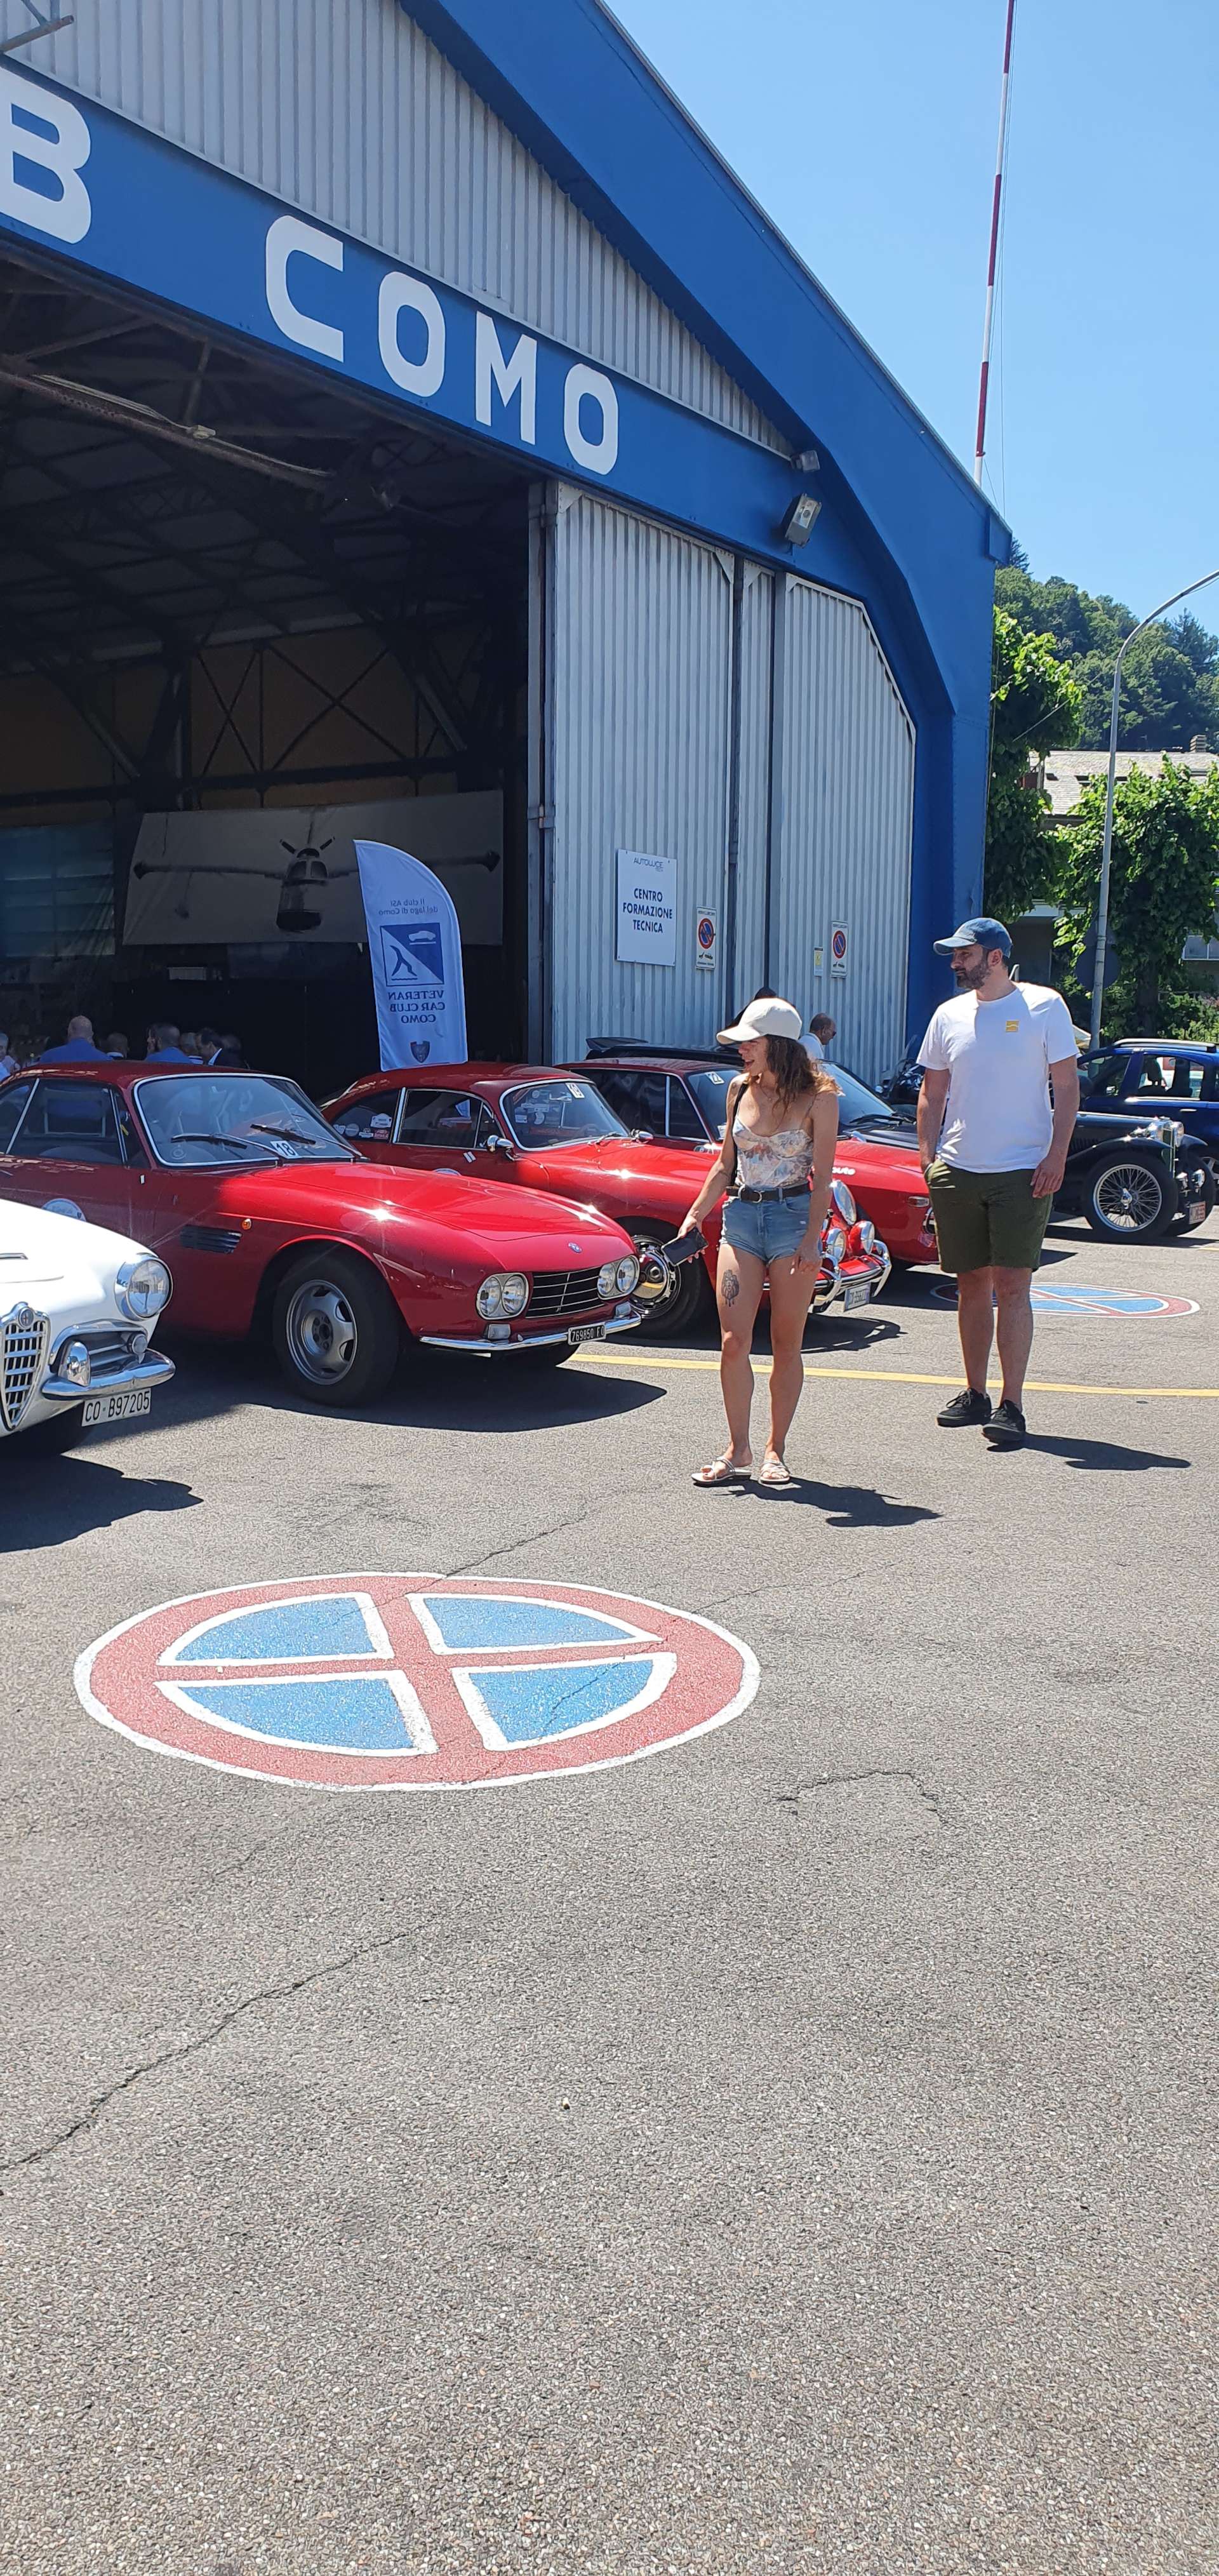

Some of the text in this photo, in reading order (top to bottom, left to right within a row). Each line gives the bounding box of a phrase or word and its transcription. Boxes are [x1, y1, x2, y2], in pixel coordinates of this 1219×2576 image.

[265, 215, 619, 476] COMO
[634, 888, 663, 902] CENTRO
[623, 902, 672, 919] FORMAZIONE
[633, 919, 663, 933] TECNICA
[276, 1143, 296, 1156] 18
[571, 1328, 594, 1342] 769850
